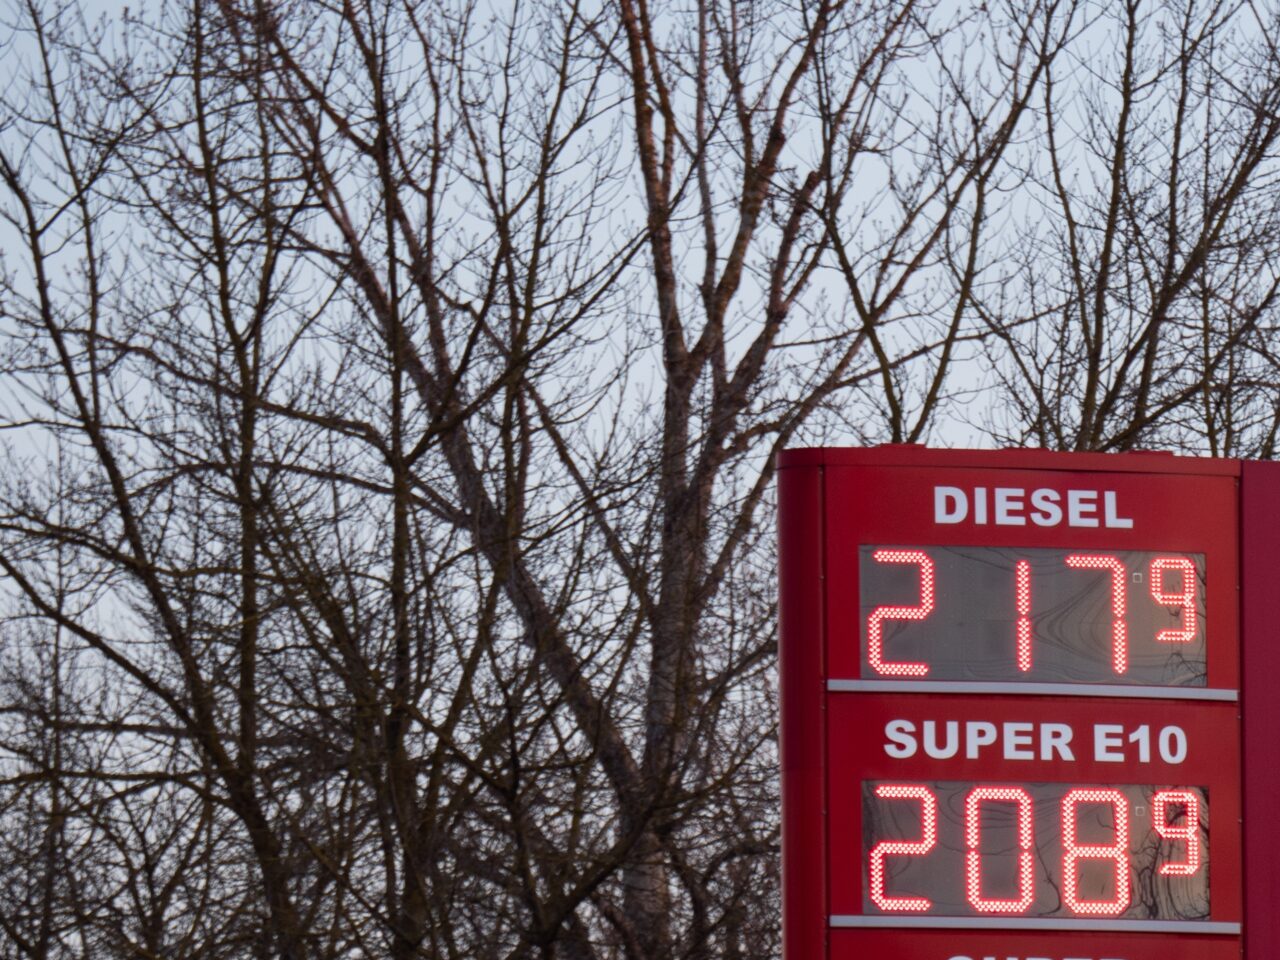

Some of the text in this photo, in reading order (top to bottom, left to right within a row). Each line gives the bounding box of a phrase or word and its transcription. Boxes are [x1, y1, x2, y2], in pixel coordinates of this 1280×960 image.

[934, 486, 1134, 529] DIESEL
[883, 719, 1188, 765] SUPER E10
